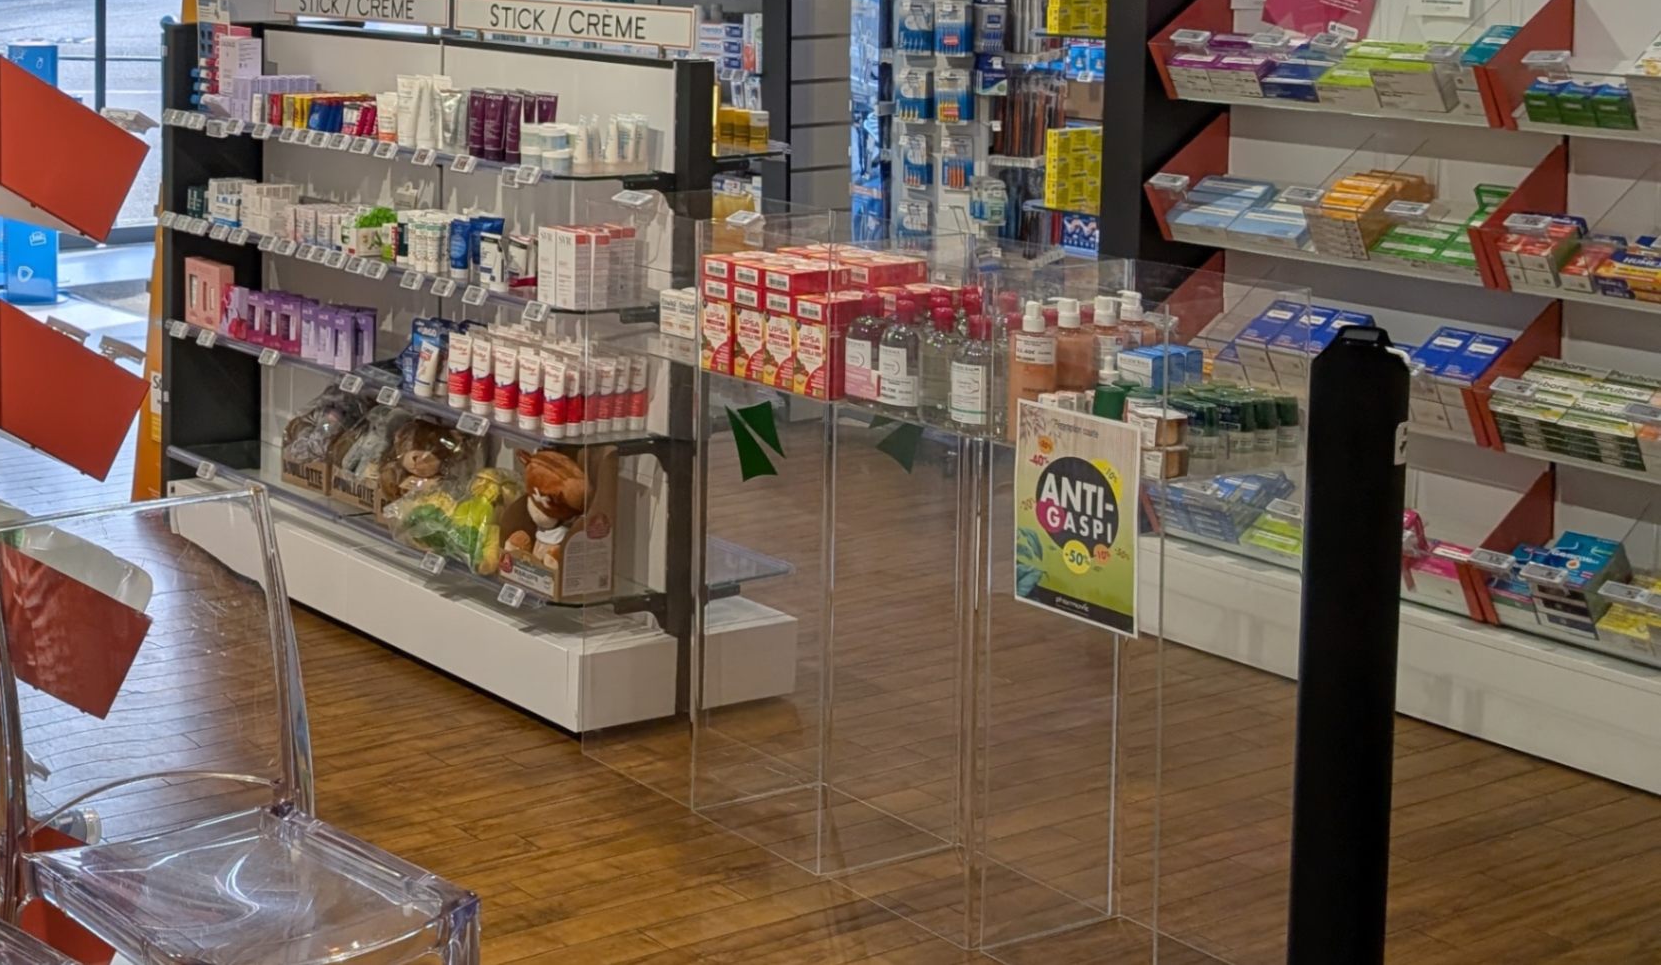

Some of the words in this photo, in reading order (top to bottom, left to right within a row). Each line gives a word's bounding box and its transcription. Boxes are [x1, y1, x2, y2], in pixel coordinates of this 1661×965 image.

[489, 4, 545, 31] STICK
[551, 7, 562, 33] /
[568, 9, 647, 40] CRÈME
[1040, 472, 1114, 519] ANTI-
[1047, 505, 1112, 544] GASPI
